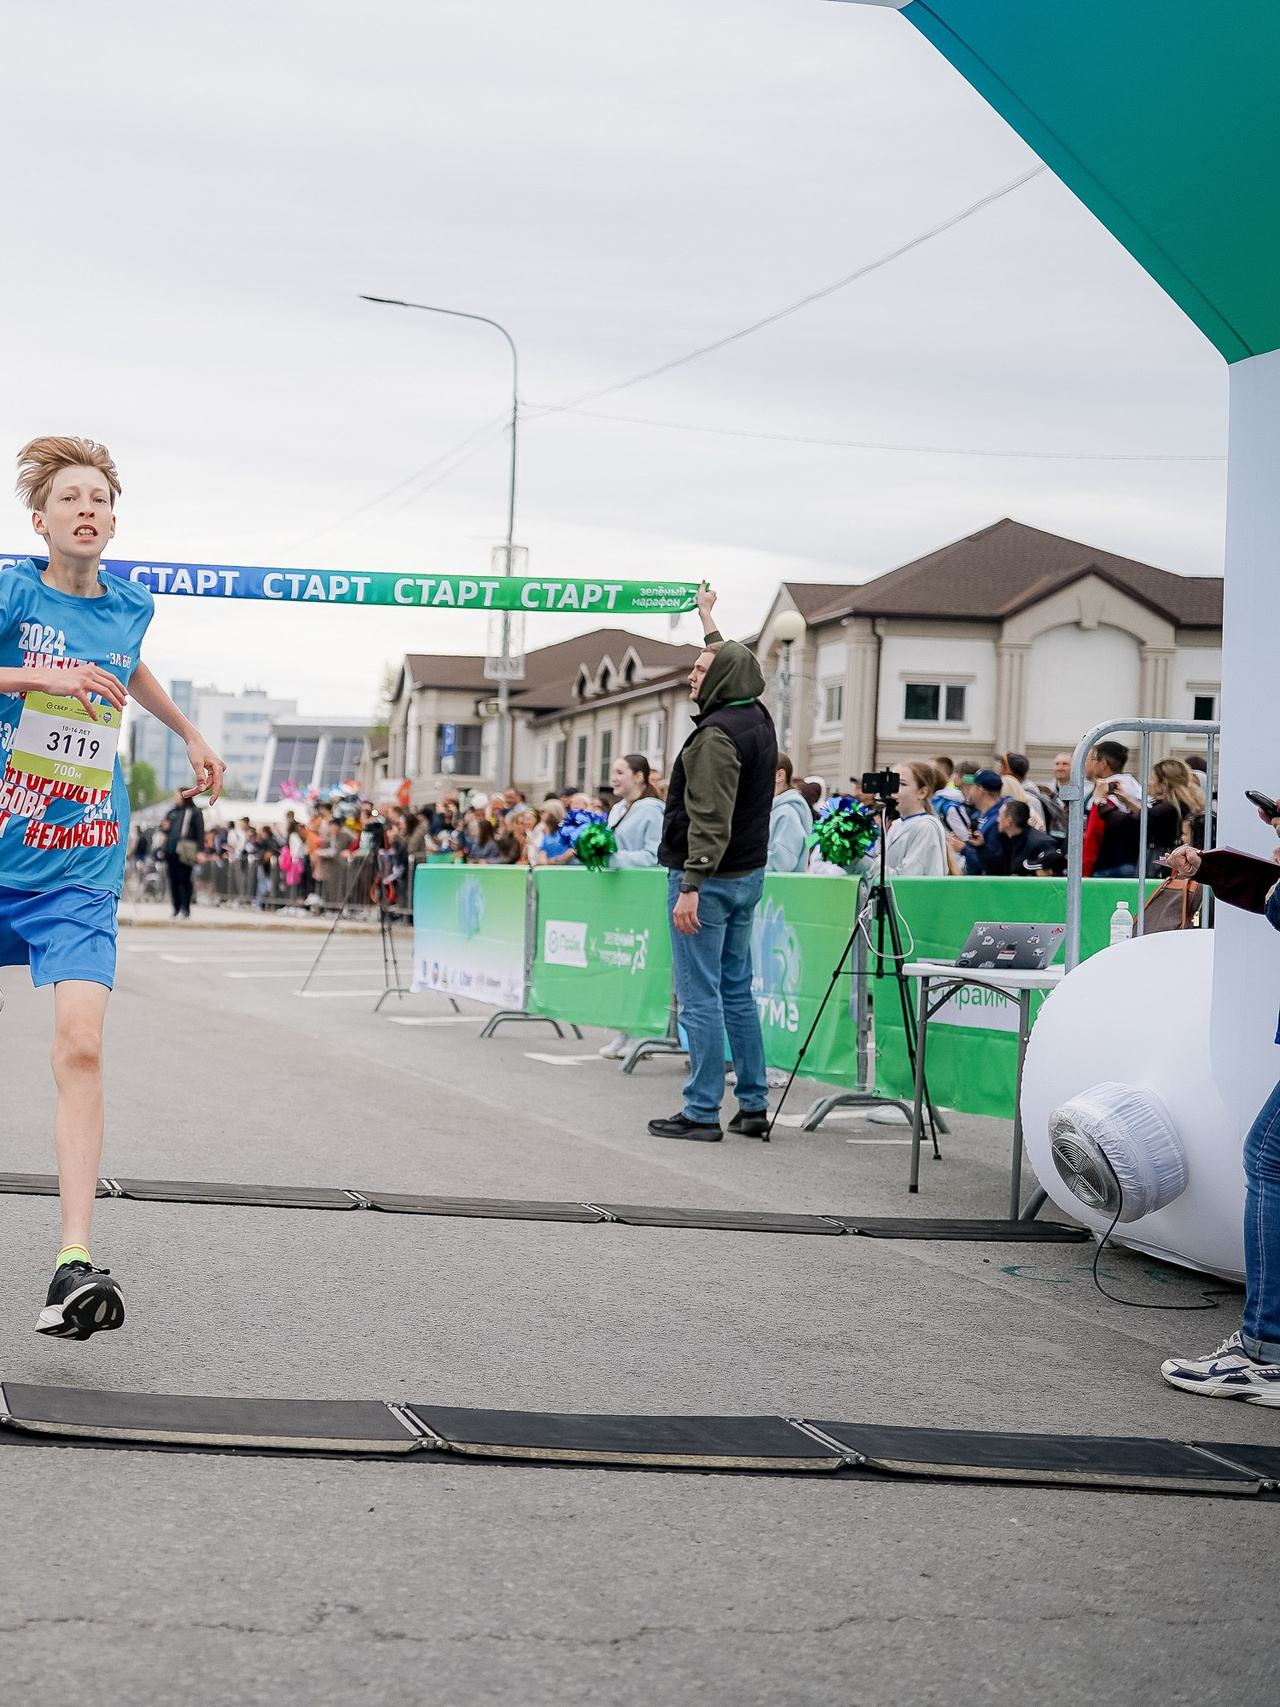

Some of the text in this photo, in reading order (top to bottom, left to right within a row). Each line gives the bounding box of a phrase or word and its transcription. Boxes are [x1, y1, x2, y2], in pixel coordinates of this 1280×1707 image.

[130, 566, 240, 596] СТАРТ
[263, 573, 371, 602] СТАРТ
[394, 578, 500, 607] СТАРТ
[520, 582, 624, 610] СТАРТ
[18, 622, 67, 655] 2024
[46, 731, 100, 760] 3119
